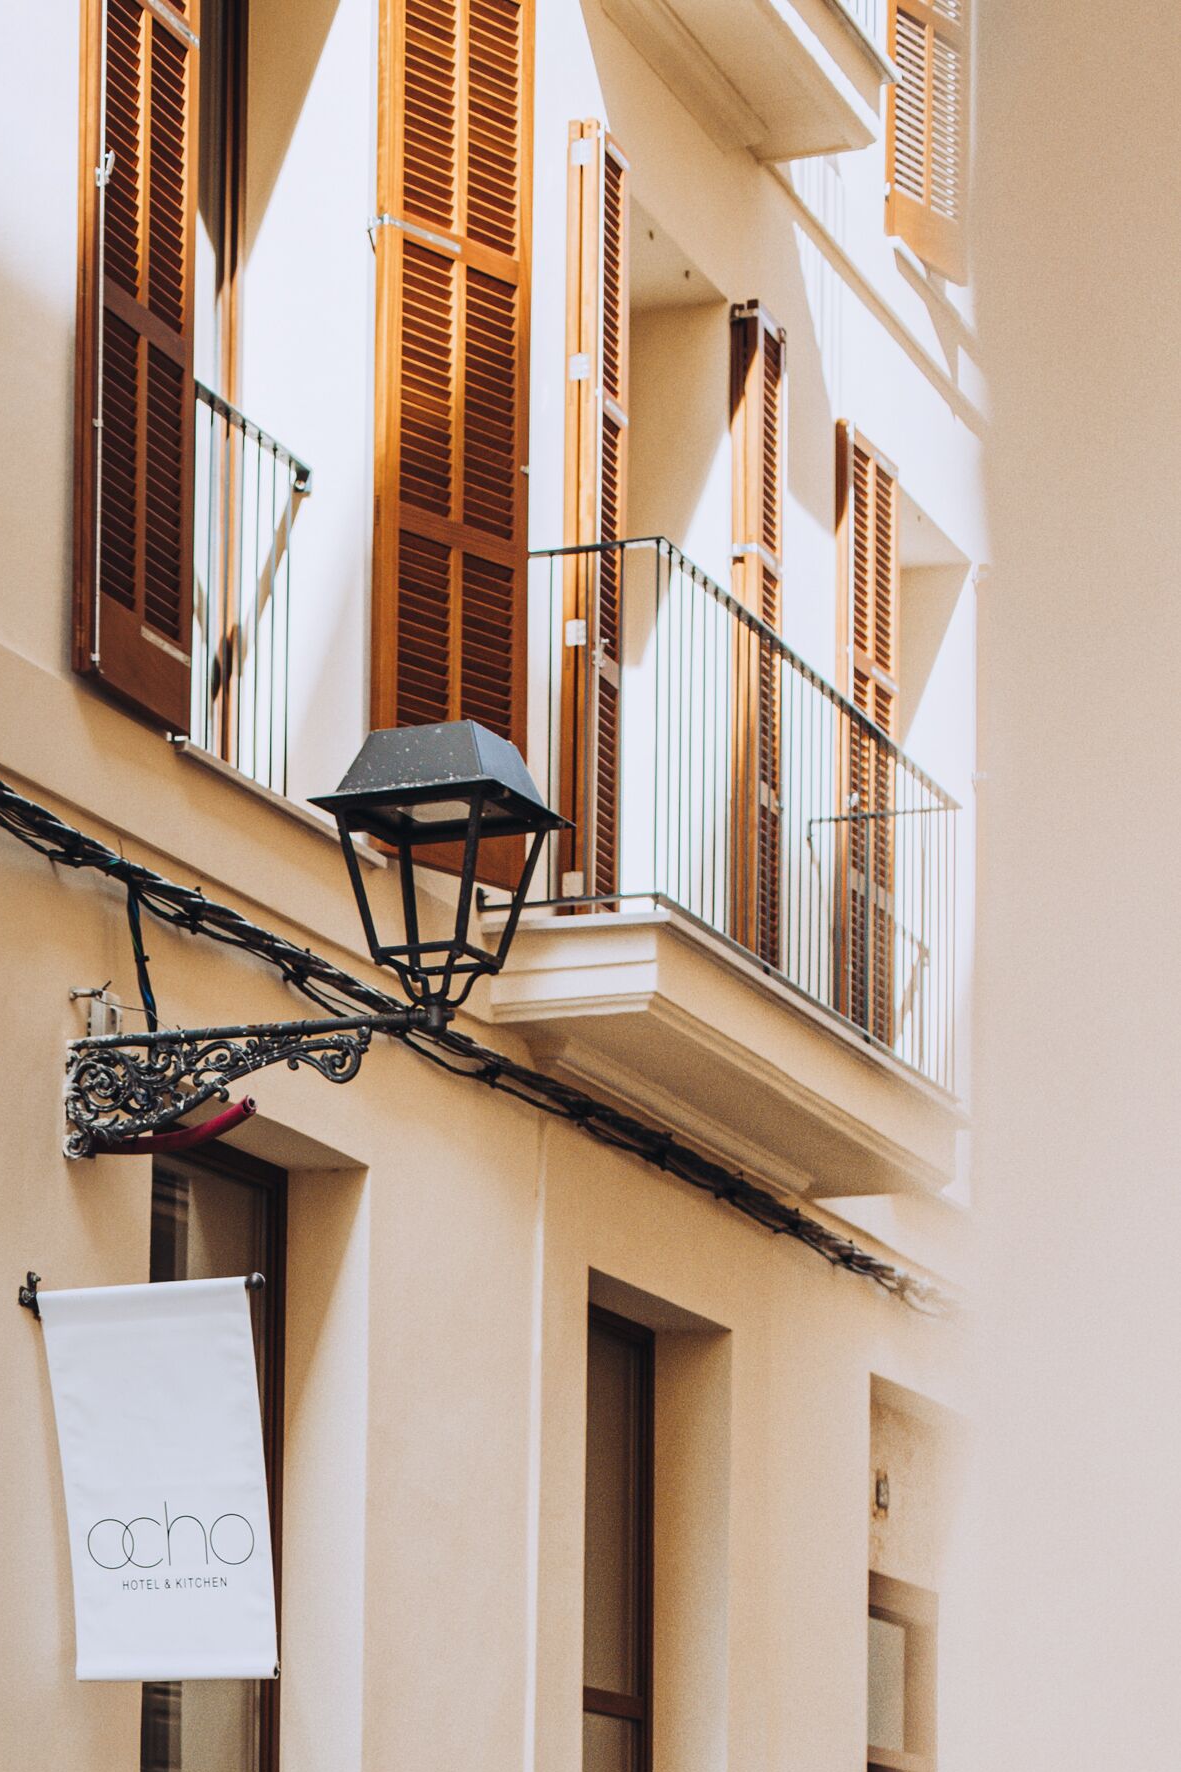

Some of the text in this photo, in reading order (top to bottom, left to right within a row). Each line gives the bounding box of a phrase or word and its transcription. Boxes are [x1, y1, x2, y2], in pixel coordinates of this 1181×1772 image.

[122, 1576, 228, 1590] HOTEL & KITCHEN
